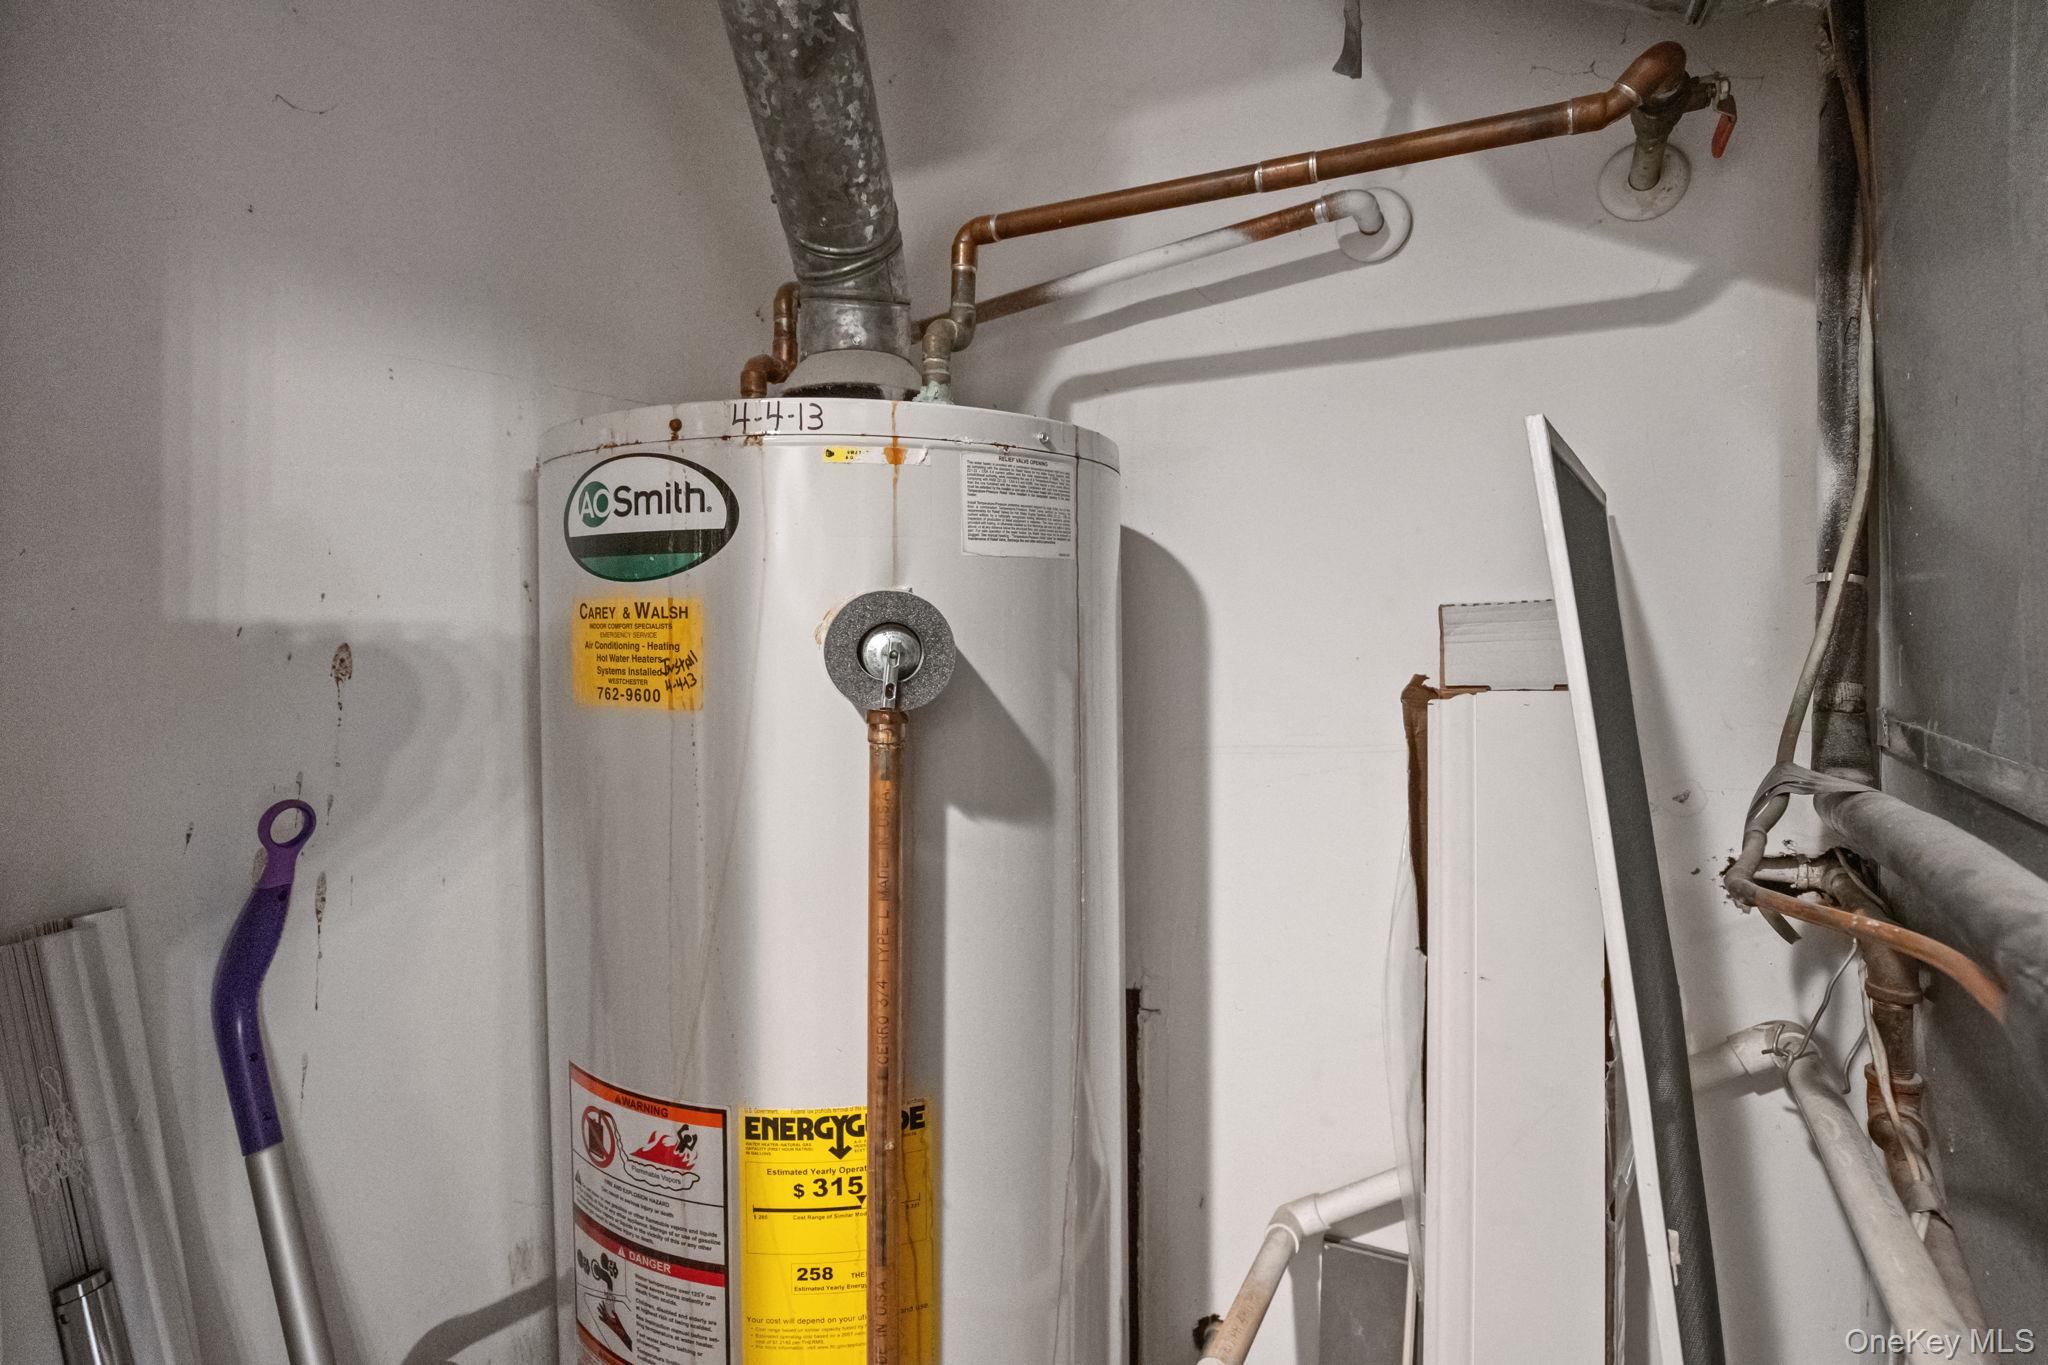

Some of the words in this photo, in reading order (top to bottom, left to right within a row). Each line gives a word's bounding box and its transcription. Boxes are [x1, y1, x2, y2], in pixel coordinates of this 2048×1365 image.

[732, 401, 823, 434] 4-4-13
[580, 603, 616, 620] CAREY
[622, 606, 631, 619] &
[634, 602, 689, 620] WALSH
[634, 623, 673, 631] SPECIALISTS
[585, 641, 593, 649] Air
[594, 641, 640, 652] Conditioning
[647, 642, 680, 653] Heating
[596, 654, 608, 662] Hot
[609, 654, 631, 663] Water
[632, 655, 662, 664] Heaters
[597, 666, 626, 676] Systems
[628, 668, 664, 677] Installed
[597, 687, 661, 703] 762-9600
[877, 927, 889, 963] TYPE
[622, 1094, 670, 1118] WARNING
[632, 1165, 660, 1180] Flammable
[661, 1174, 682, 1185] Vapors
[767, 1168, 808, 1176] Estimated
[810, 1167, 837, 1177] Yearly
[839, 1165, 867, 1175] Operat
[793, 1183, 805, 1200] $
[812, 1176, 864, 1198] 315
[807, 1213, 826, 1221] Range
[834, 1211, 854, 1219] Similar
[629, 1251, 671, 1274] DANGER
[797, 1267, 834, 1281] 258
[851, 1271, 867, 1279] THE
[794, 1284, 825, 1292] Estimated
[826, 1284, 845, 1292] Yearly
[747, 1316, 764, 1324] Your
[766, 1317, 781, 1325] cost
[783, 1317, 796, 1325] will
[797, 1317, 825, 1325] depend
[839, 1315, 856, 1325] your
